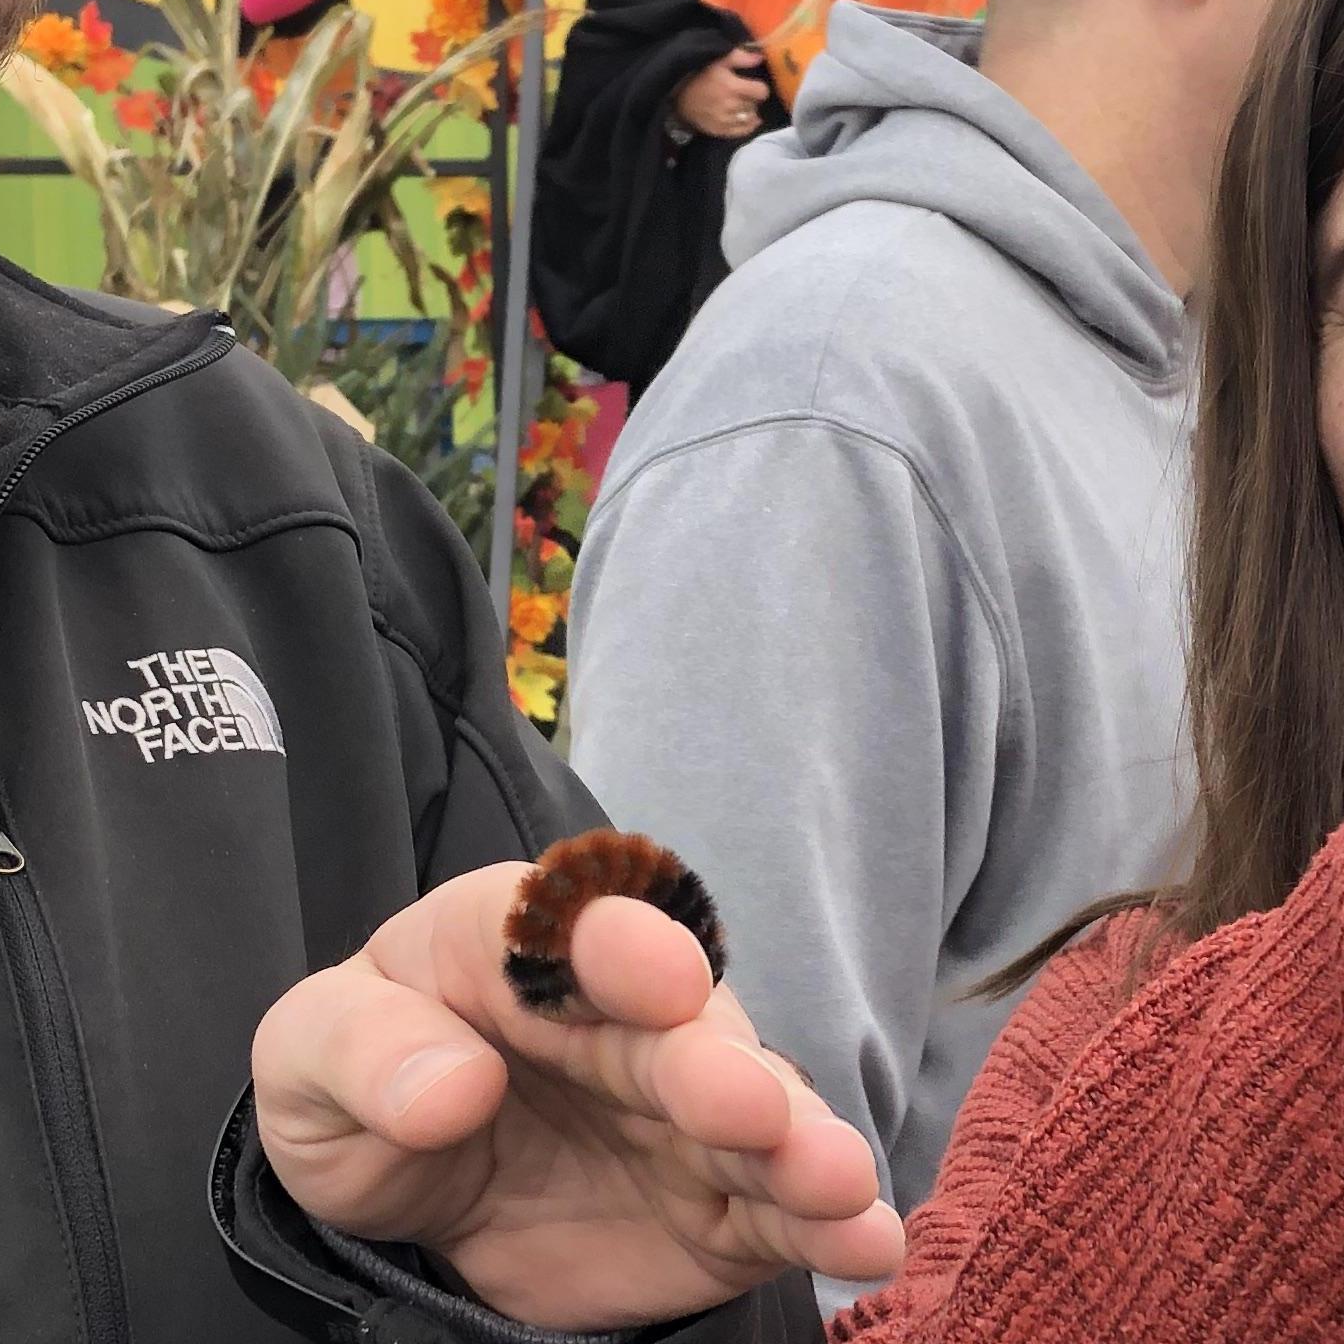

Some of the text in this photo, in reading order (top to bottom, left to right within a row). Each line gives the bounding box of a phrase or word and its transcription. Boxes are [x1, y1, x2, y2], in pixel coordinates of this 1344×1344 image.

[126, 649, 218, 688] THE
[81, 682, 232, 735] NORTH
[134, 716, 245, 763] FACE
